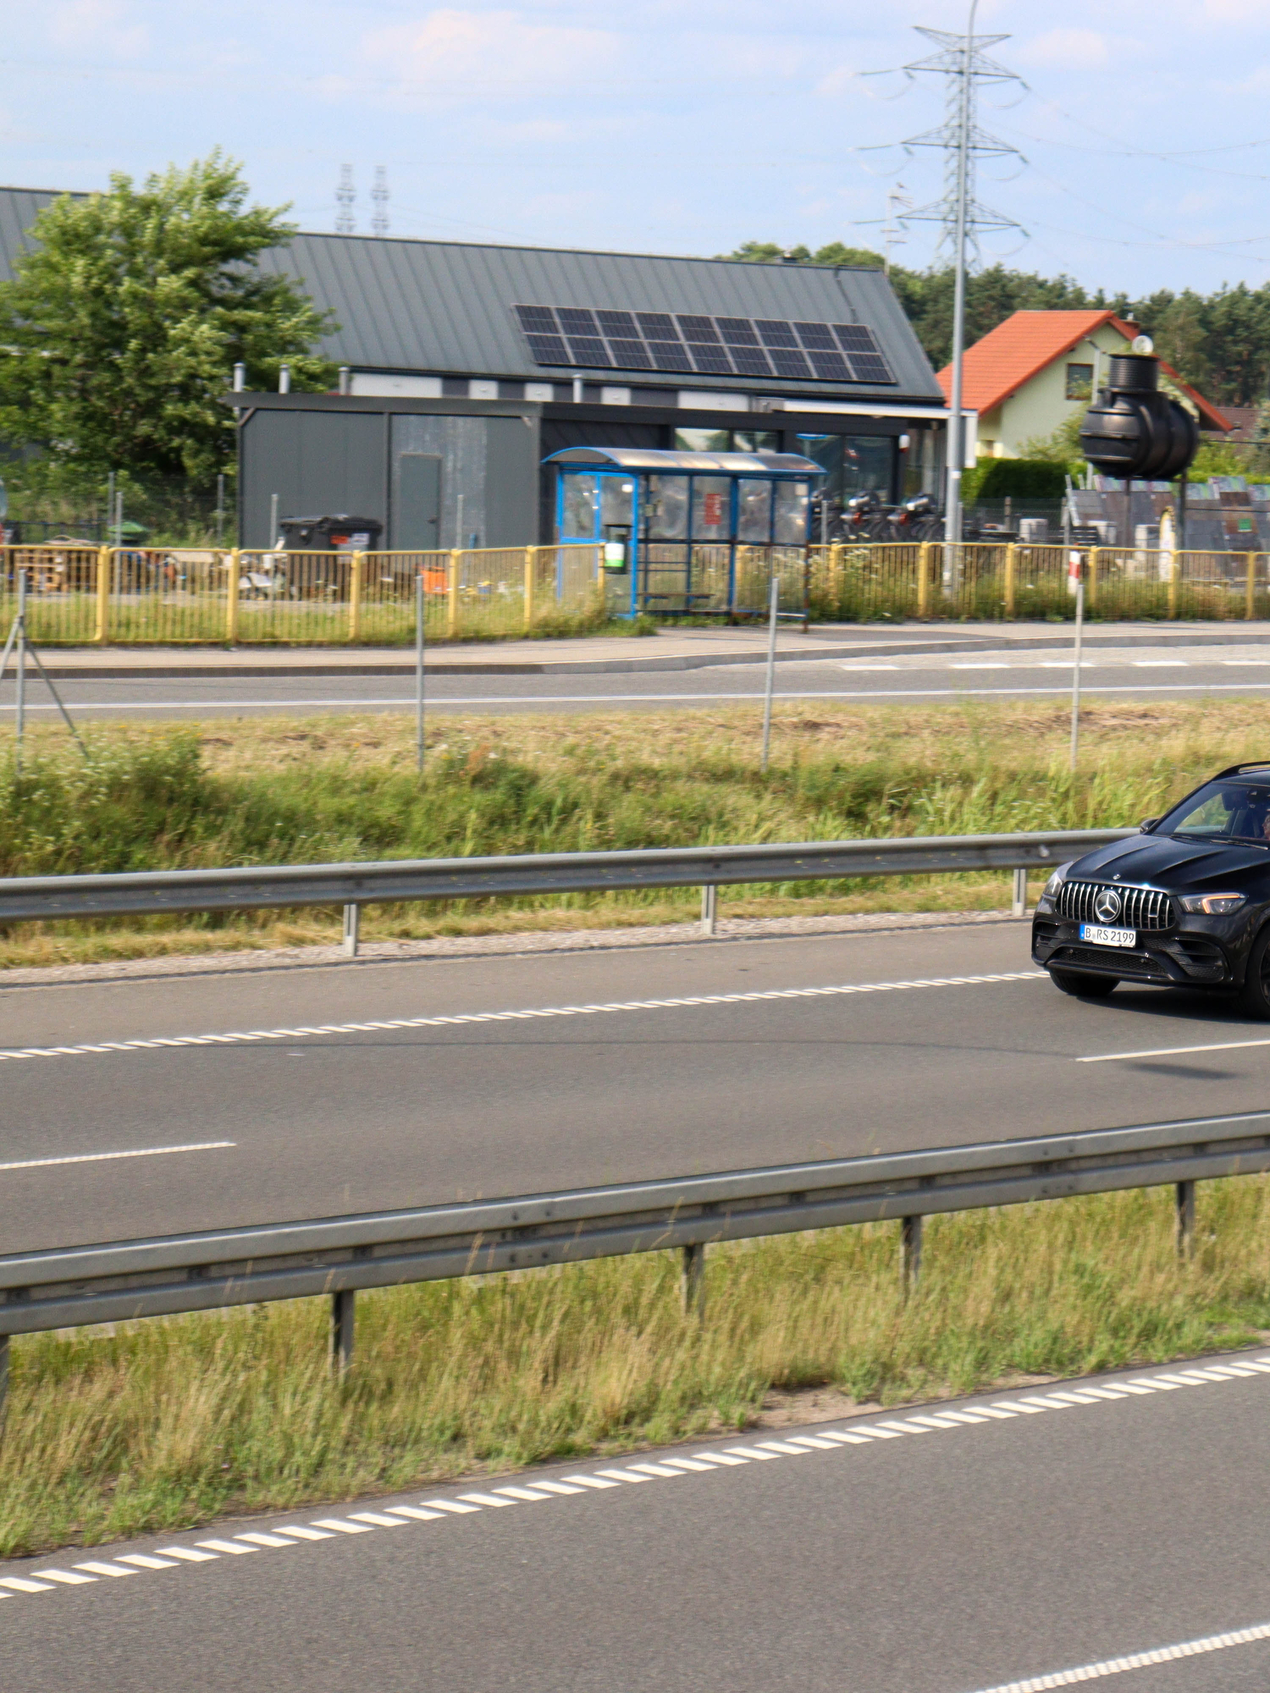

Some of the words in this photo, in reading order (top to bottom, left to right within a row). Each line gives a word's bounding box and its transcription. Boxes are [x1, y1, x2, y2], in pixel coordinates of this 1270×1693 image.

[1085, 927, 1091, 939] B
[1096, 928, 1109, 941] RS
[1110, 930, 1135, 944] 2199
